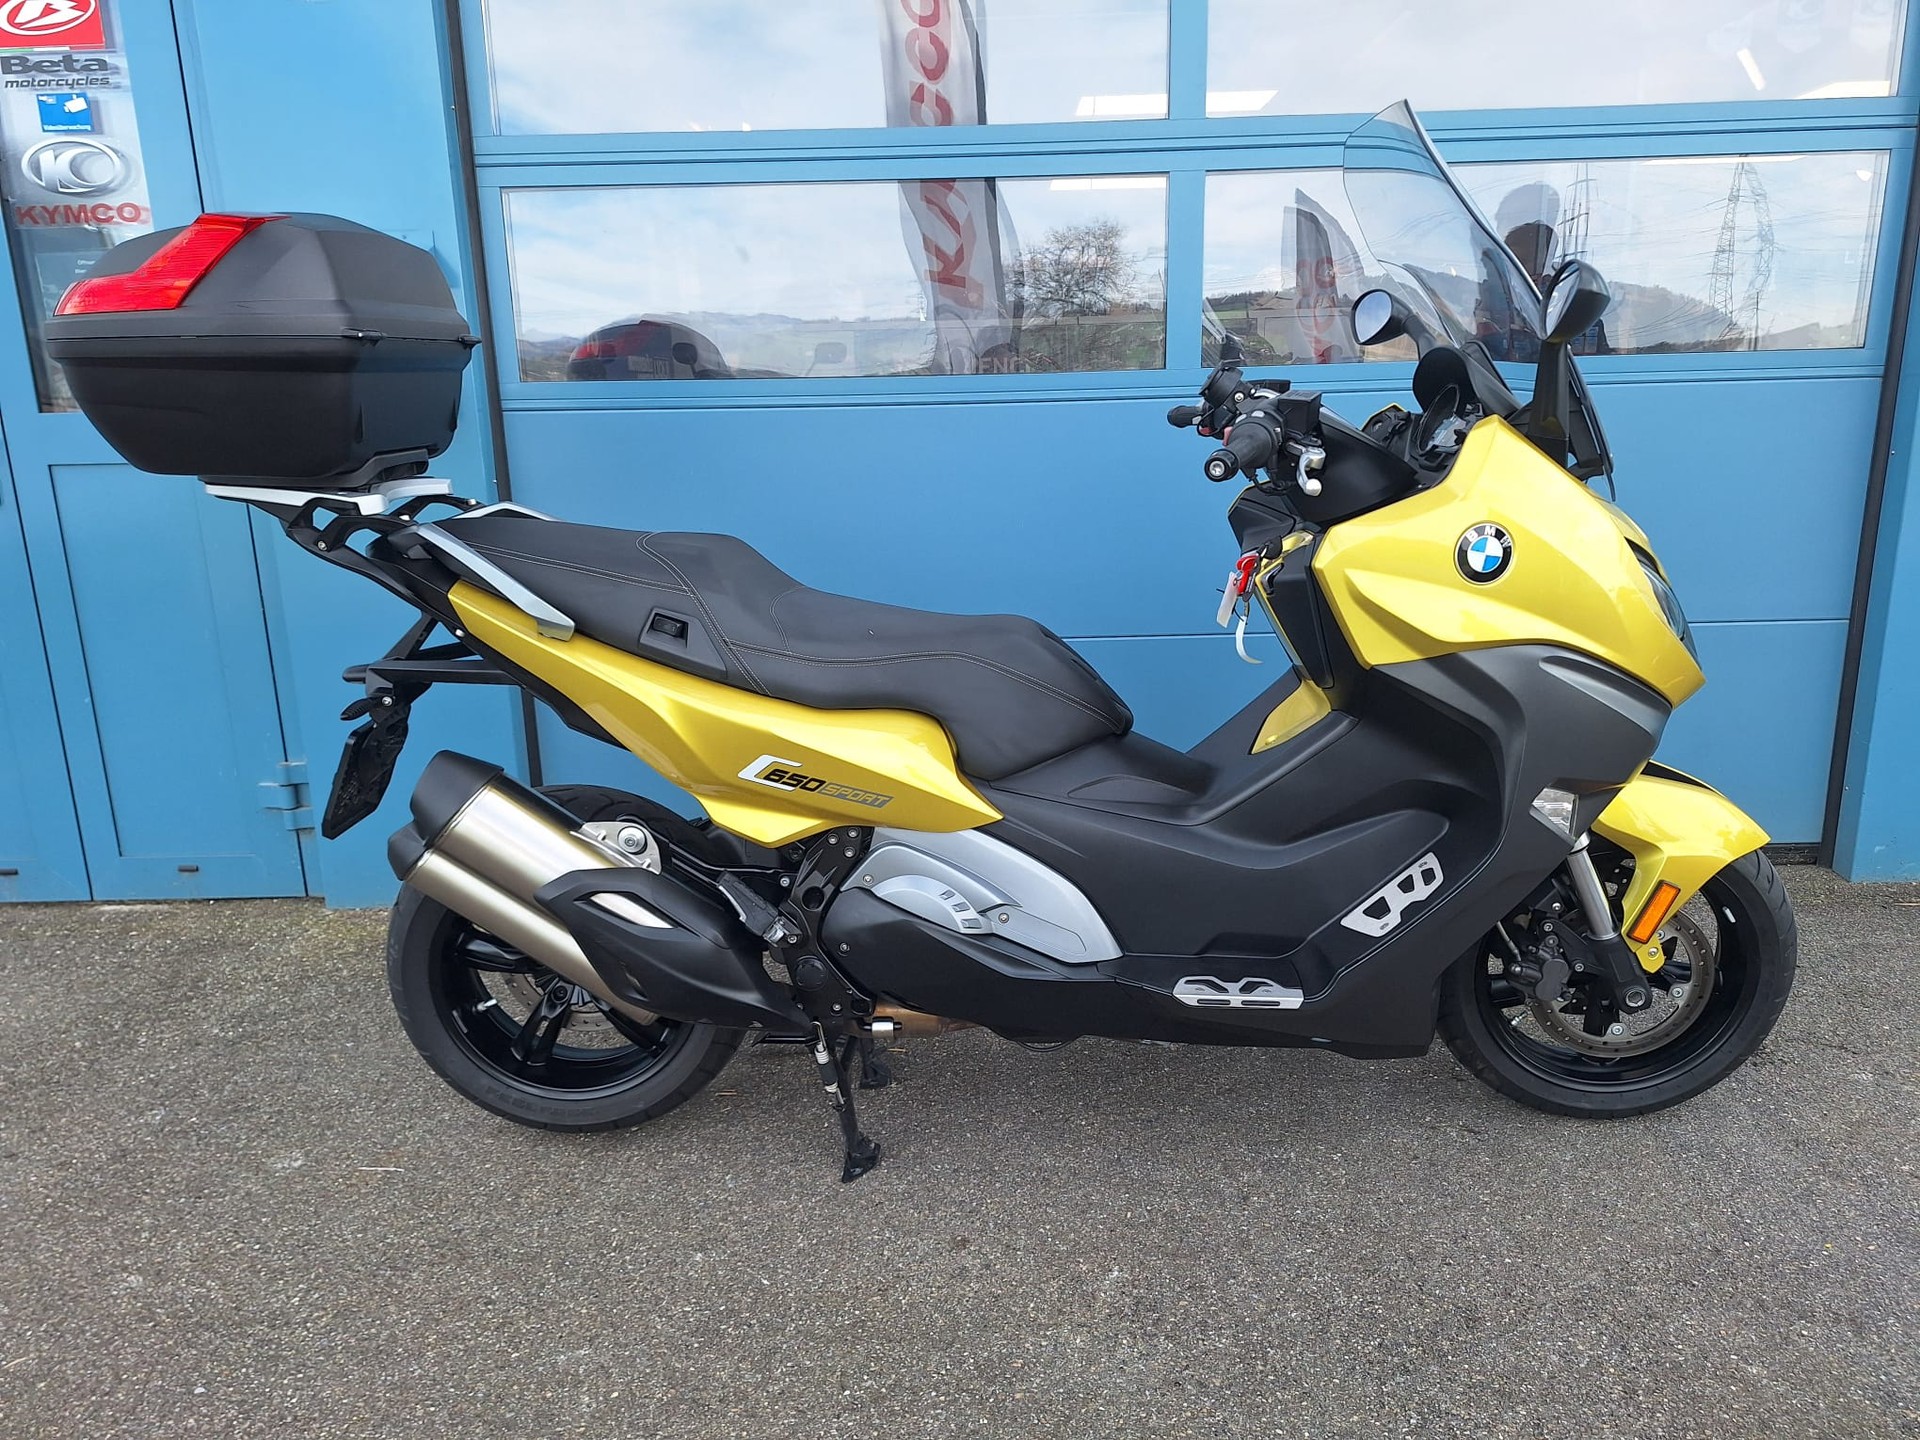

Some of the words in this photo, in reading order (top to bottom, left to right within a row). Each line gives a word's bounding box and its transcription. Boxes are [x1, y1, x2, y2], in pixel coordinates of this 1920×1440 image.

[0, 54, 108, 74] Beta
[5, 76, 110, 89] motorcycles
[16, 202, 141, 225] KYMCO
[1465, 525, 1512, 549] BMW
